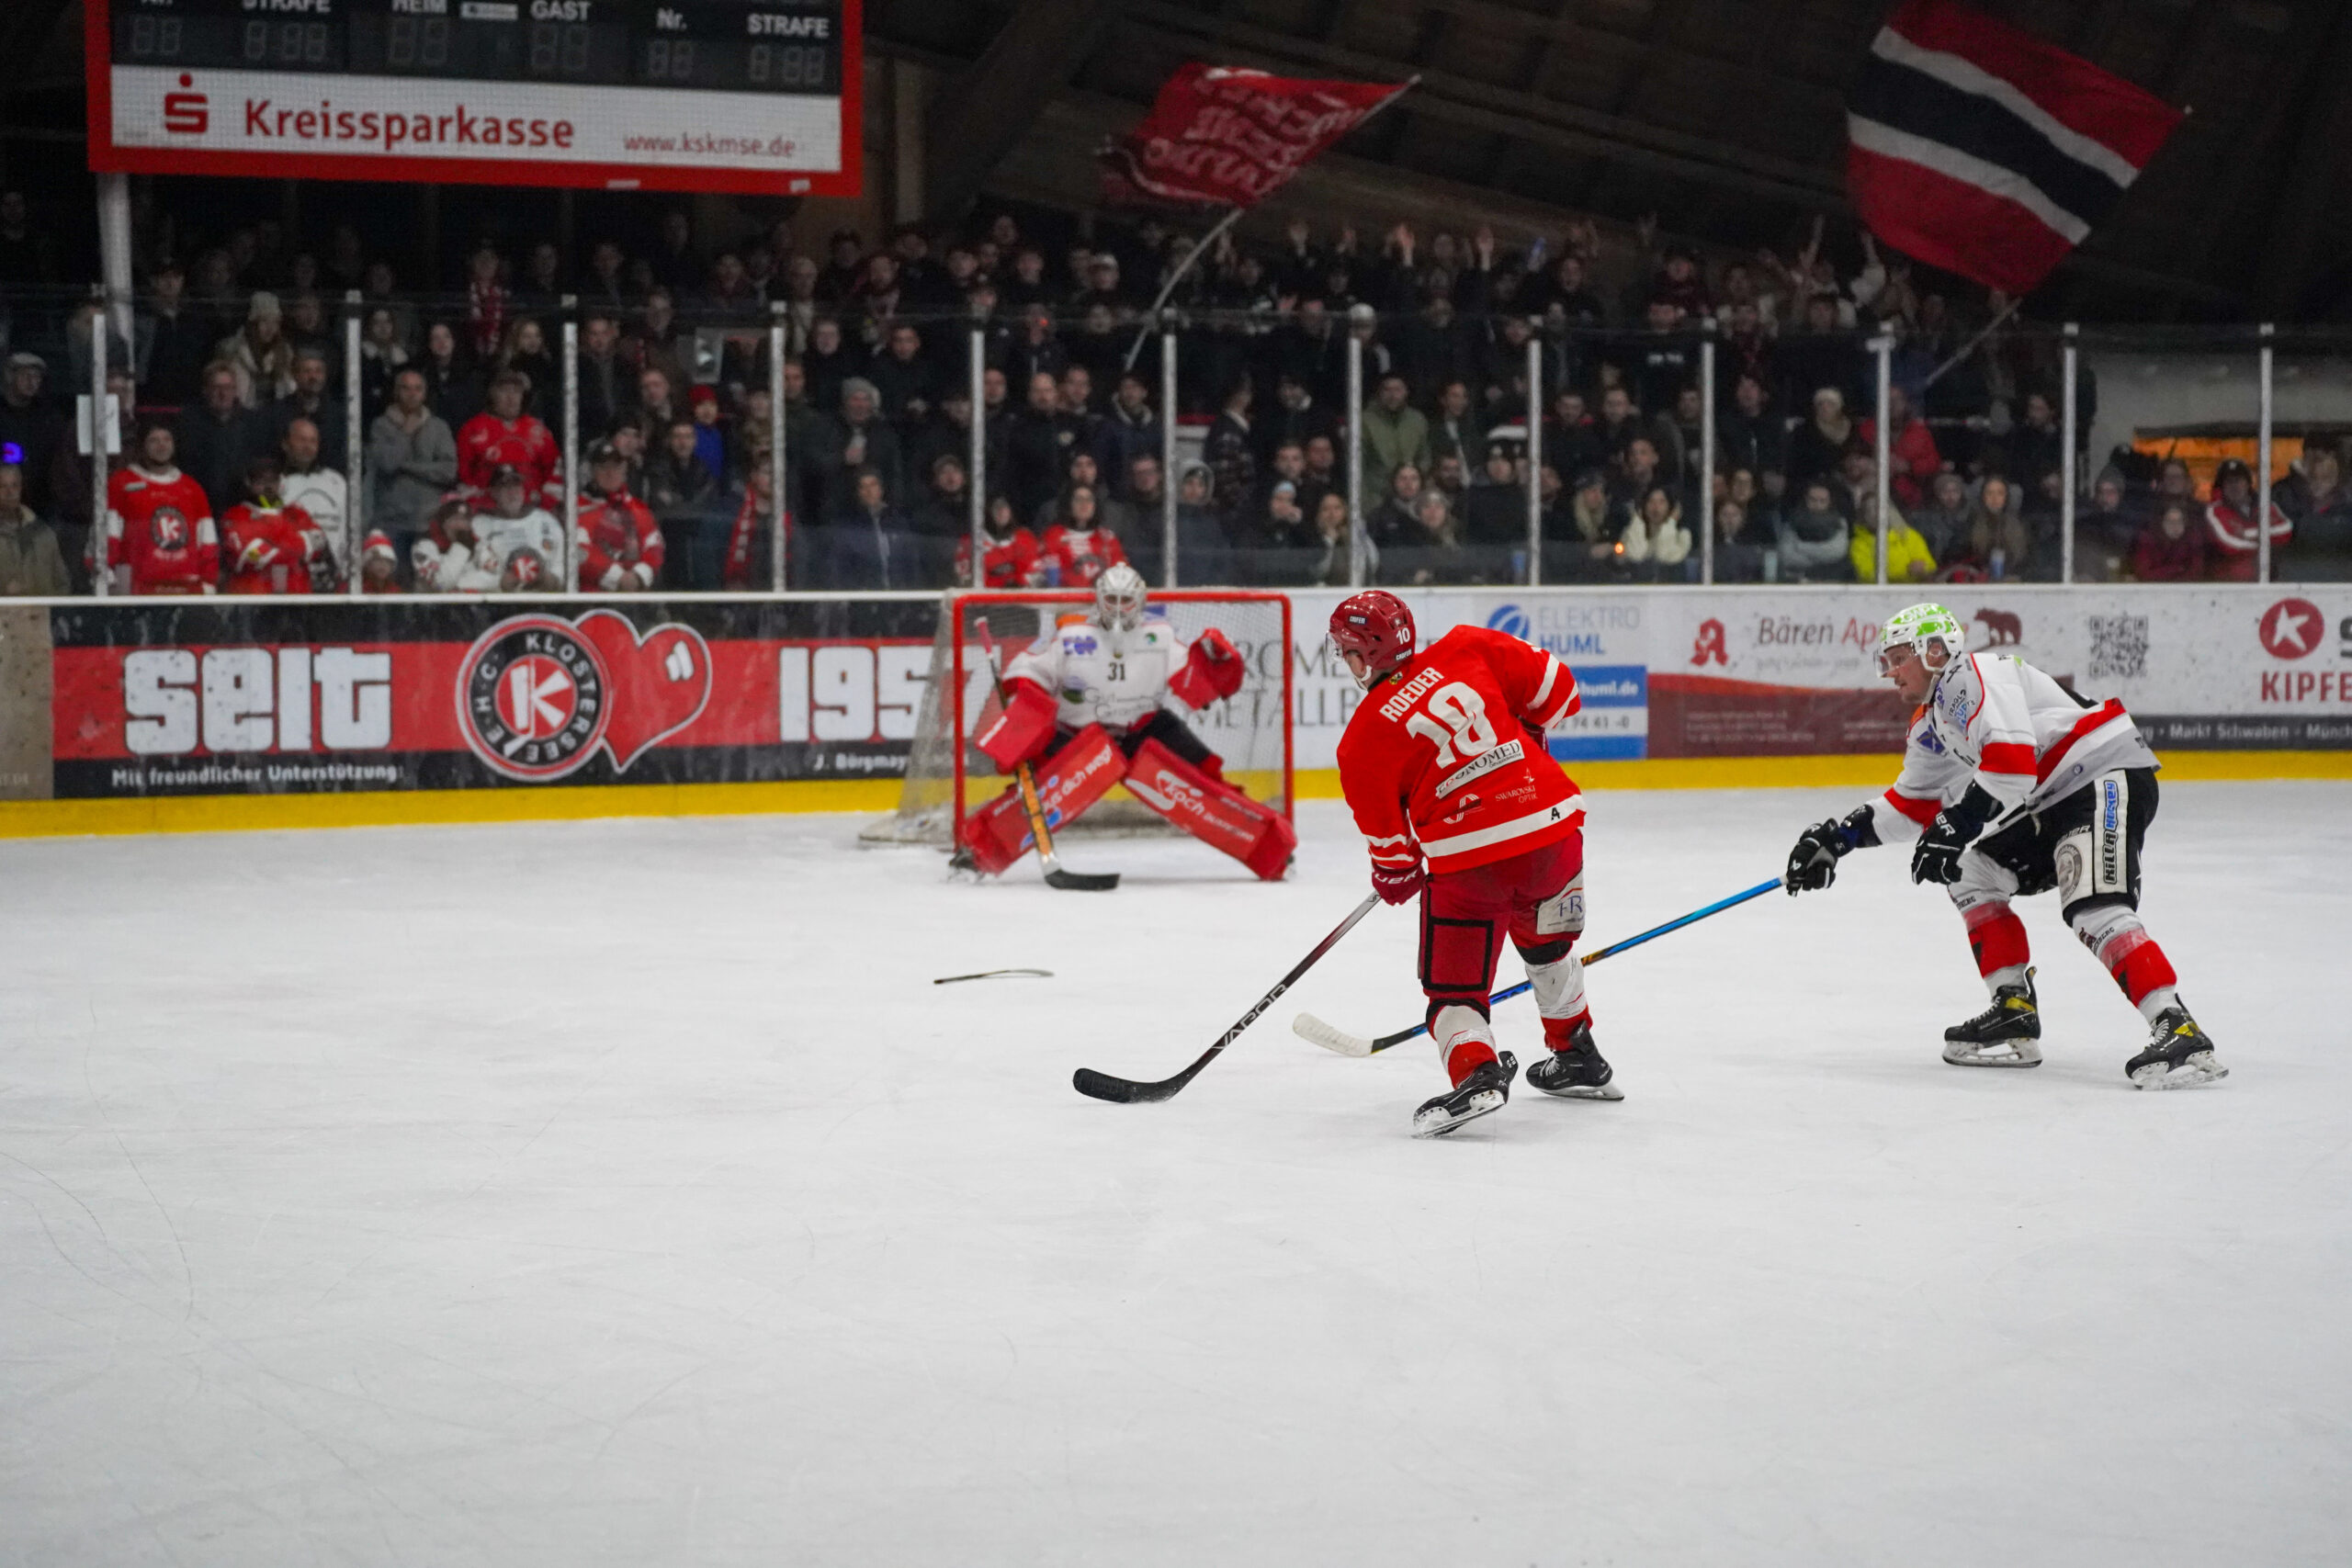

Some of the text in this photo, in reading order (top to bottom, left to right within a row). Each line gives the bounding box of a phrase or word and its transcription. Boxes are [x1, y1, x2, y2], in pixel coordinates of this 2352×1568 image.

[530, 1, 591, 20] GAST
[747, 13, 829, 38] STRAFE
[245, 98, 573, 151] Kreissparkasse
[624, 131, 796, 158] www.kskmse.de
[1540, 606, 1641, 630] ELEKTRO
[1396, 627, 1411, 645] 10
[1758, 616, 1834, 645] Bären
[1541, 634, 1605, 655] HUML
[1107, 661, 1126, 682] 31
[1378, 666, 1445, 723] ROEDER
[111, 769, 144, 787] Mit
[149, 766, 263, 785] freundlicher
[1495, 784, 1537, 803] SWAROVSKI
[1518, 793, 1539, 804] OPTIK
[1550, 807, 1561, 821] A
[1211, 983, 1287, 1049] VAPOR
